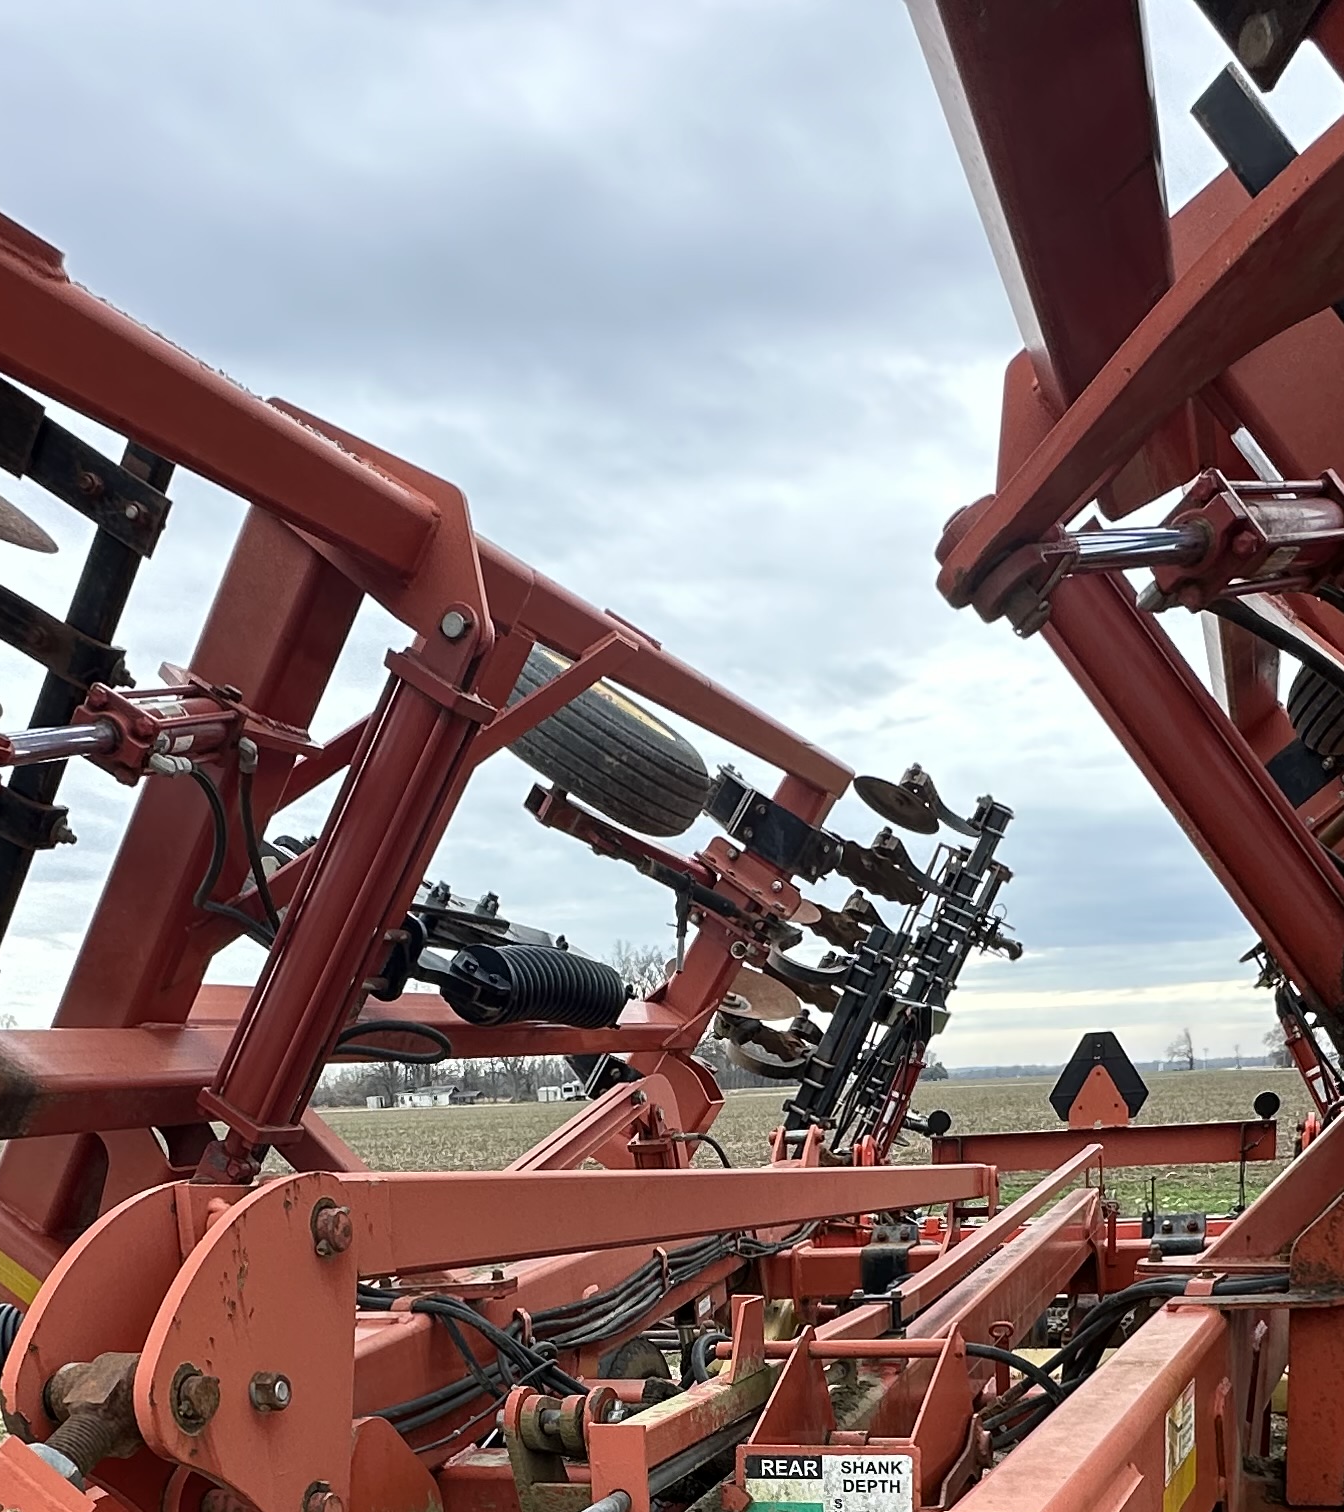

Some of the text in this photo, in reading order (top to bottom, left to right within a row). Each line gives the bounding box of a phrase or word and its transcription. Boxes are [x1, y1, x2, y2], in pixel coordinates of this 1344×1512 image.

[760, 1458, 819, 1477] REAR
[840, 1460, 904, 1475] SHANK
[842, 1478, 902, 1494] DEPTH
